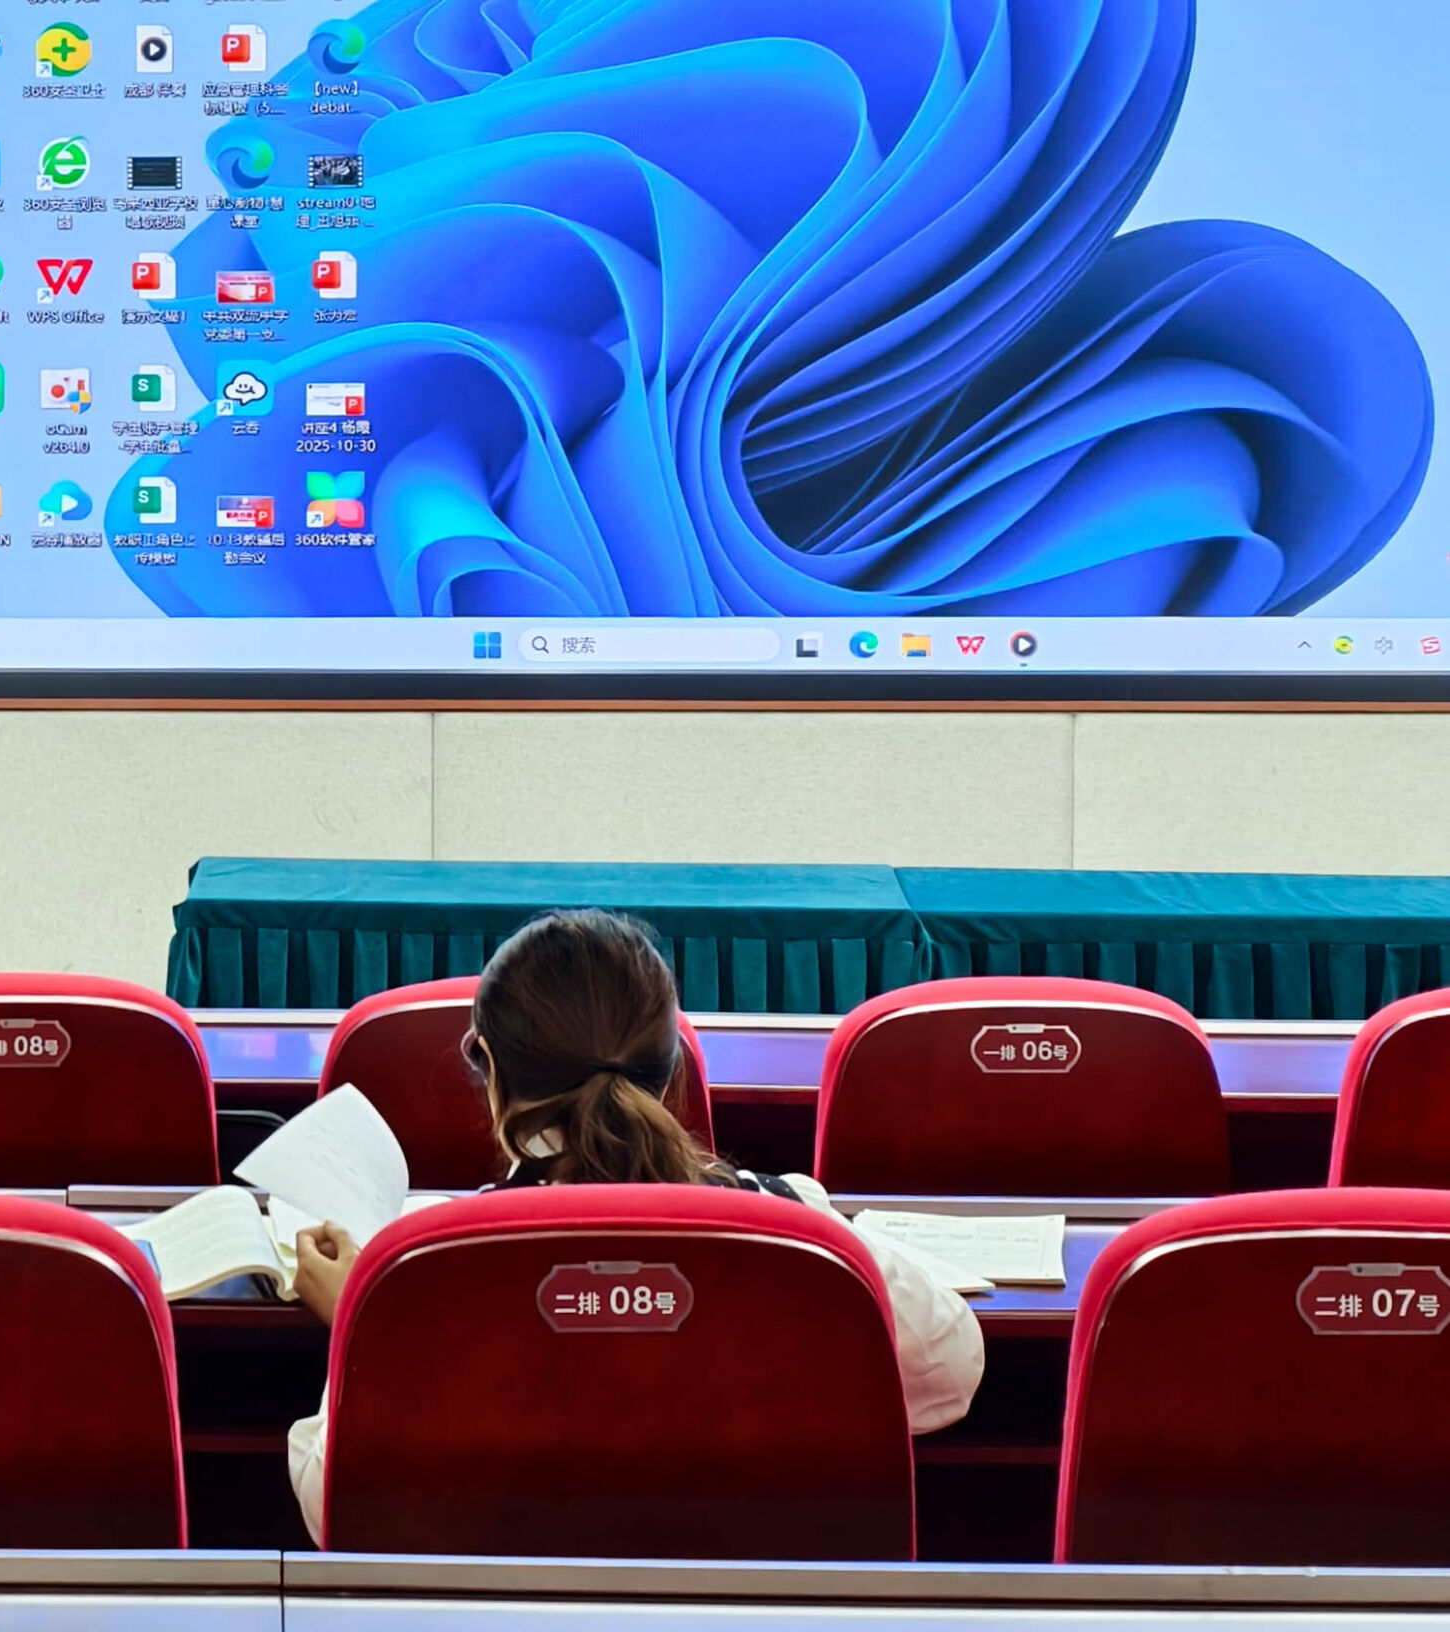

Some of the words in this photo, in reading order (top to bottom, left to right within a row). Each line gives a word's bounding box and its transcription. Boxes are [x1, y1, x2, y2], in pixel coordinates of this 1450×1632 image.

[23, 83, 106, 99] 360安全卫士
[27, 310, 60, 324] WPS
[61, 310, 105, 325] Office
[296, 440, 376, 453] 2025-10-30
[295, 532, 376, 547] 360软件管家
[562, 636, 596, 655] 搜索
[13, 1035, 59, 1056] 08号
[982, 1044, 1016, 1061] 一排
[1022, 1040, 1069, 1061] 06号
[554, 1291, 601, 1315] 二排
[609, 1285, 677, 1315] 08号
[1314, 1293, 1363, 1318] 二排
[1372, 1288, 1441, 1318] 07号
